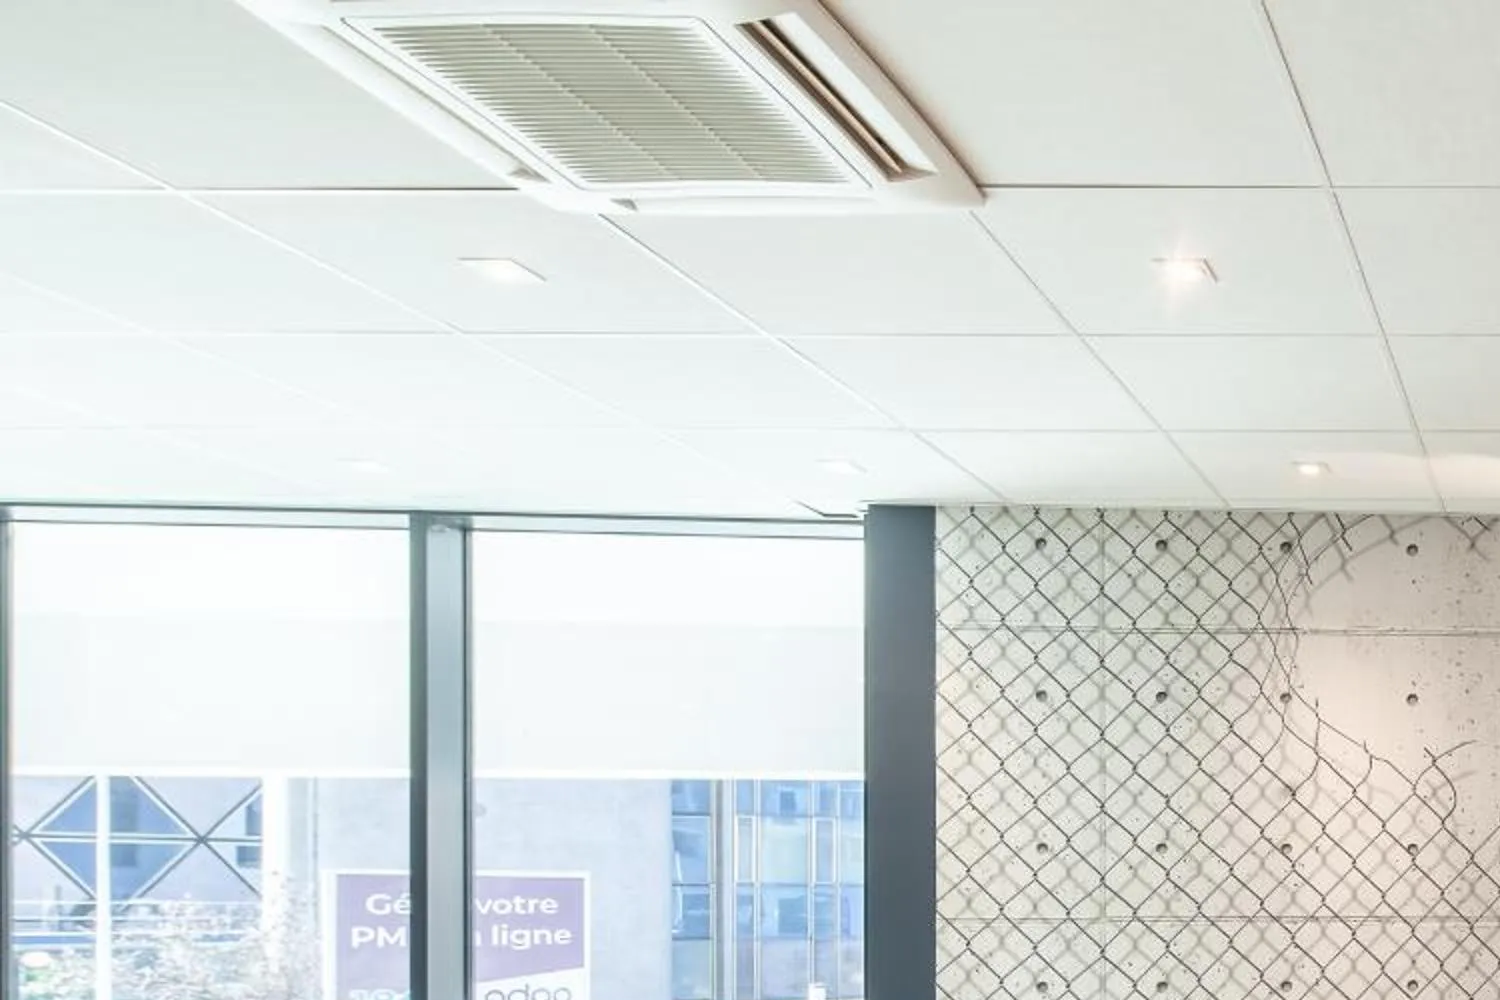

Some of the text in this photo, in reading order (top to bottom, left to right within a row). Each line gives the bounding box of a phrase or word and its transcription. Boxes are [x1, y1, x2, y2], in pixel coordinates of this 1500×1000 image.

[475, 895, 559, 915] votre
[351, 926, 408, 949] PM
[491, 924, 572, 951] ligne
